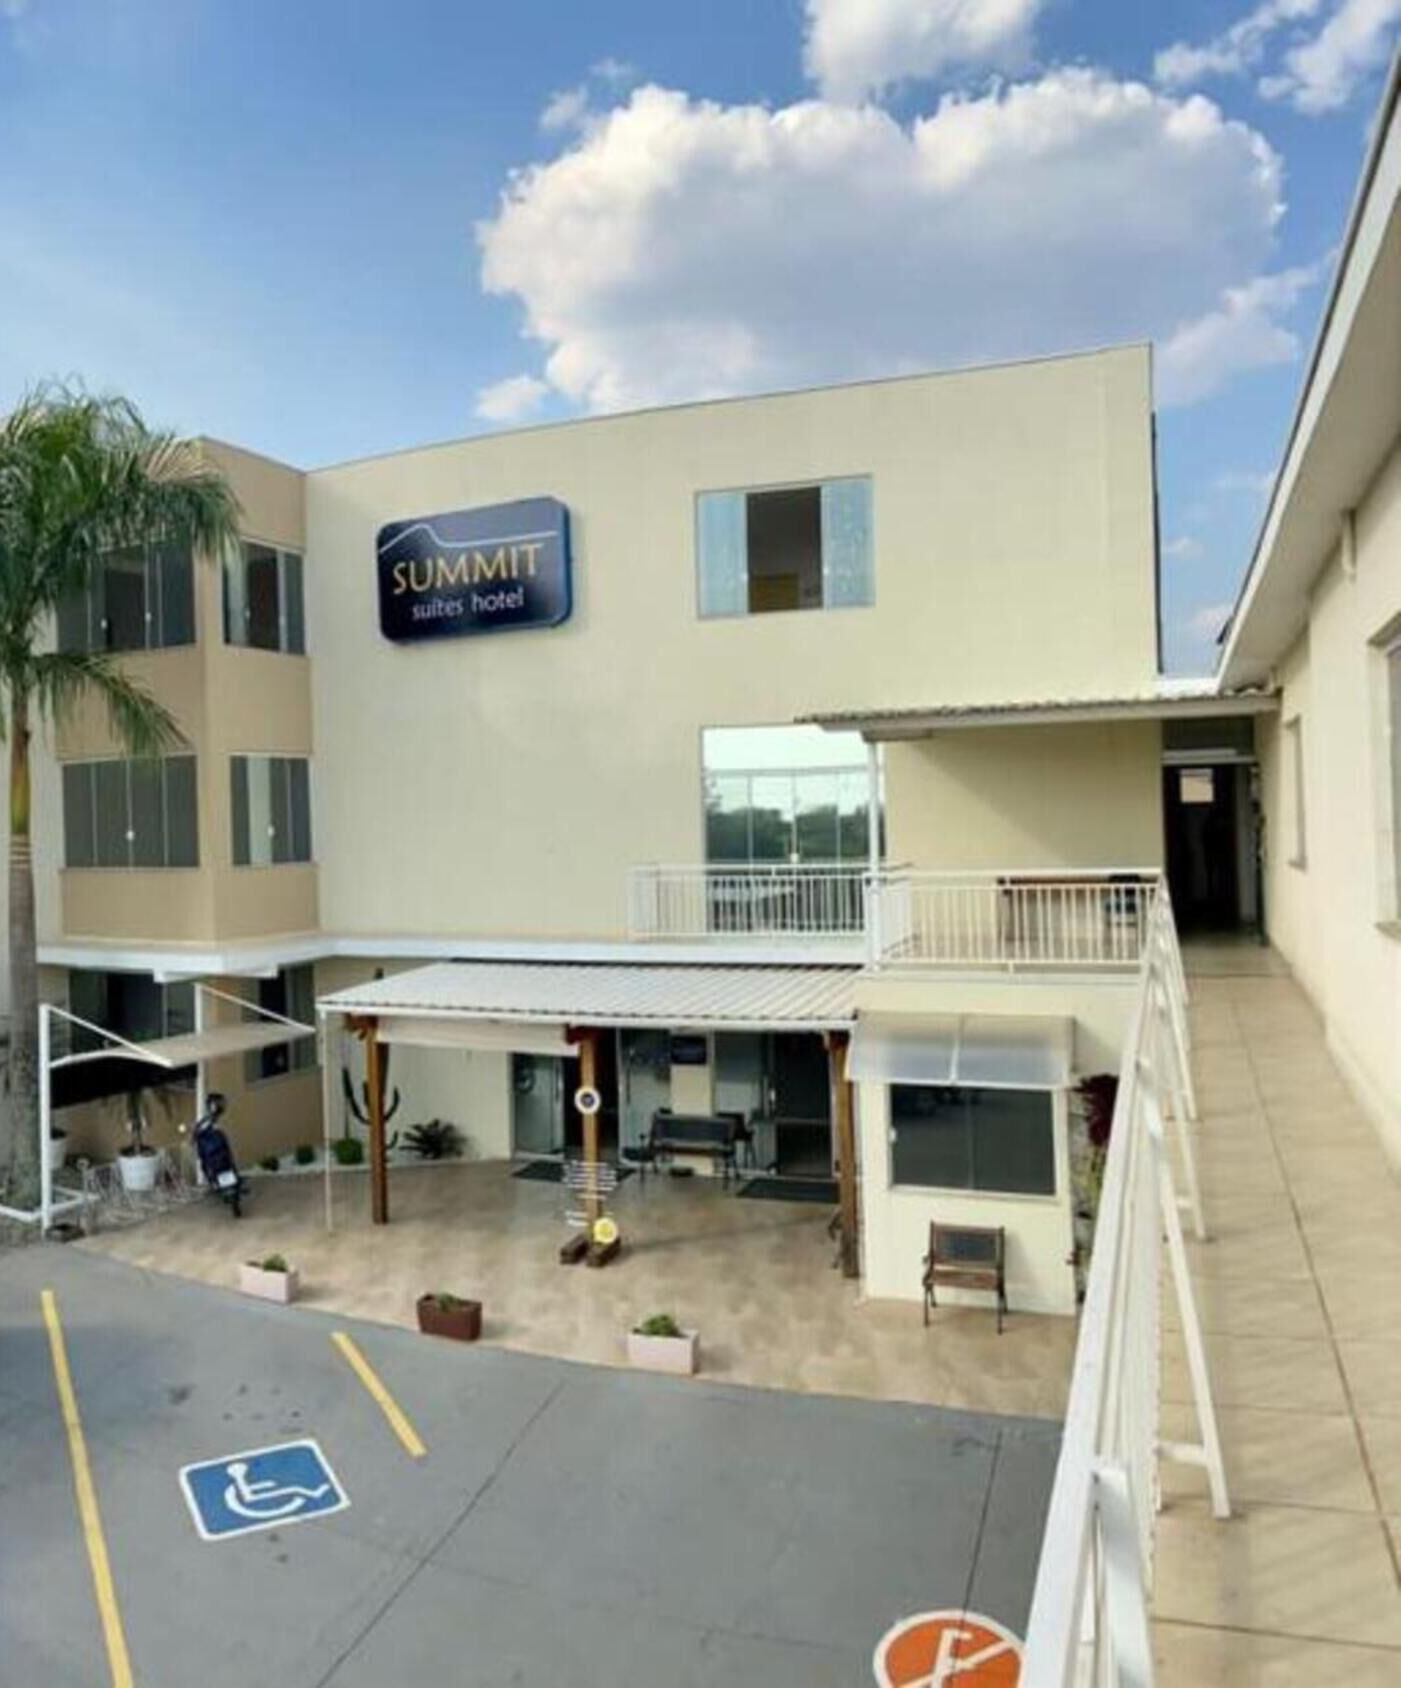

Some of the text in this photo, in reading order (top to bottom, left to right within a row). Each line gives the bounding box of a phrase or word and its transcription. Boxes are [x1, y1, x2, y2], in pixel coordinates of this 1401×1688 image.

[392, 543, 543, 594] SUMMIT
[412, 587, 524, 621] suites hotel
